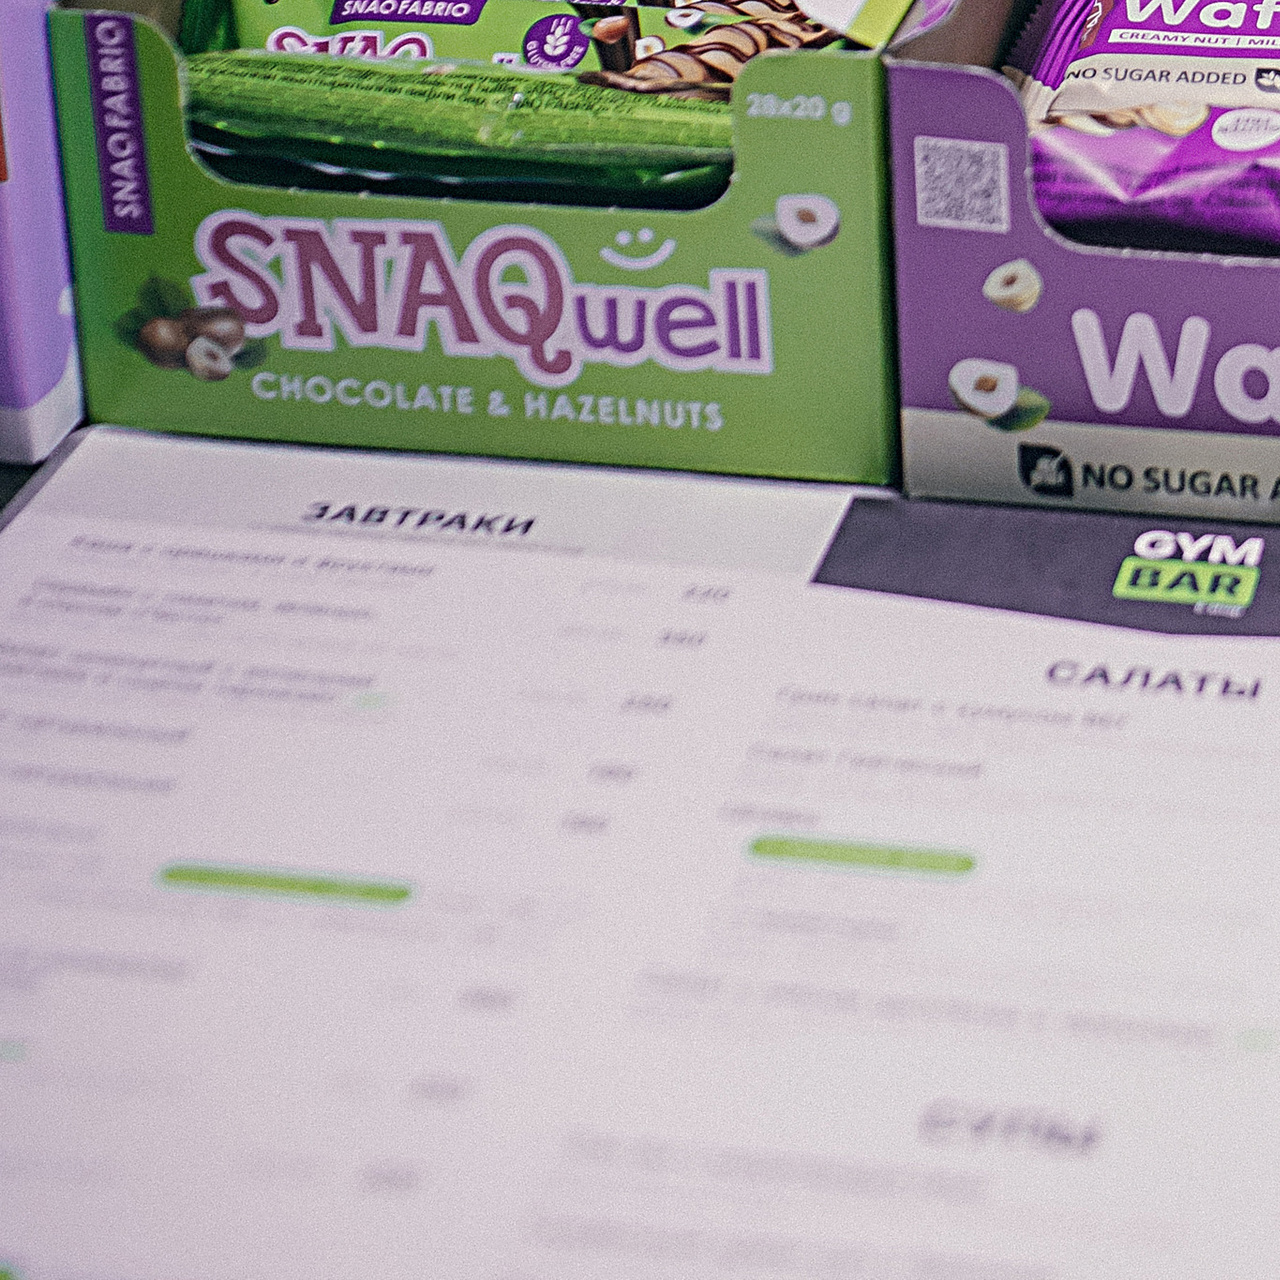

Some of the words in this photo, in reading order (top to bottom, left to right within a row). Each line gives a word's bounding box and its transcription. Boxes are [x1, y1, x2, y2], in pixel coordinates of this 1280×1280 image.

[1119, 32, 1190, 44] CREAMY
[1194, 36, 1230, 46] NUT
[1066, 66, 1097, 81] NO
[1102, 68, 1170, 83] SUGAR
[1176, 70, 1246, 85] ADDED
[746, 93, 826, 124] 28x20
[833, 100, 853, 126] g
[250, 372, 473, 417] CHOCOLATE
[487, 390, 510, 419] &
[524, 390, 725, 432] HAZELNUTS
[1081, 462, 1133, 493] NO
[1145, 465, 1260, 501] SUGAR
[304, 503, 536, 536] ЗАВТРАКИ
[1134, 530, 1265, 567] GYM
[1129, 568, 1241, 595] BAR
[1047, 658, 1264, 701] САЛАТЫ
